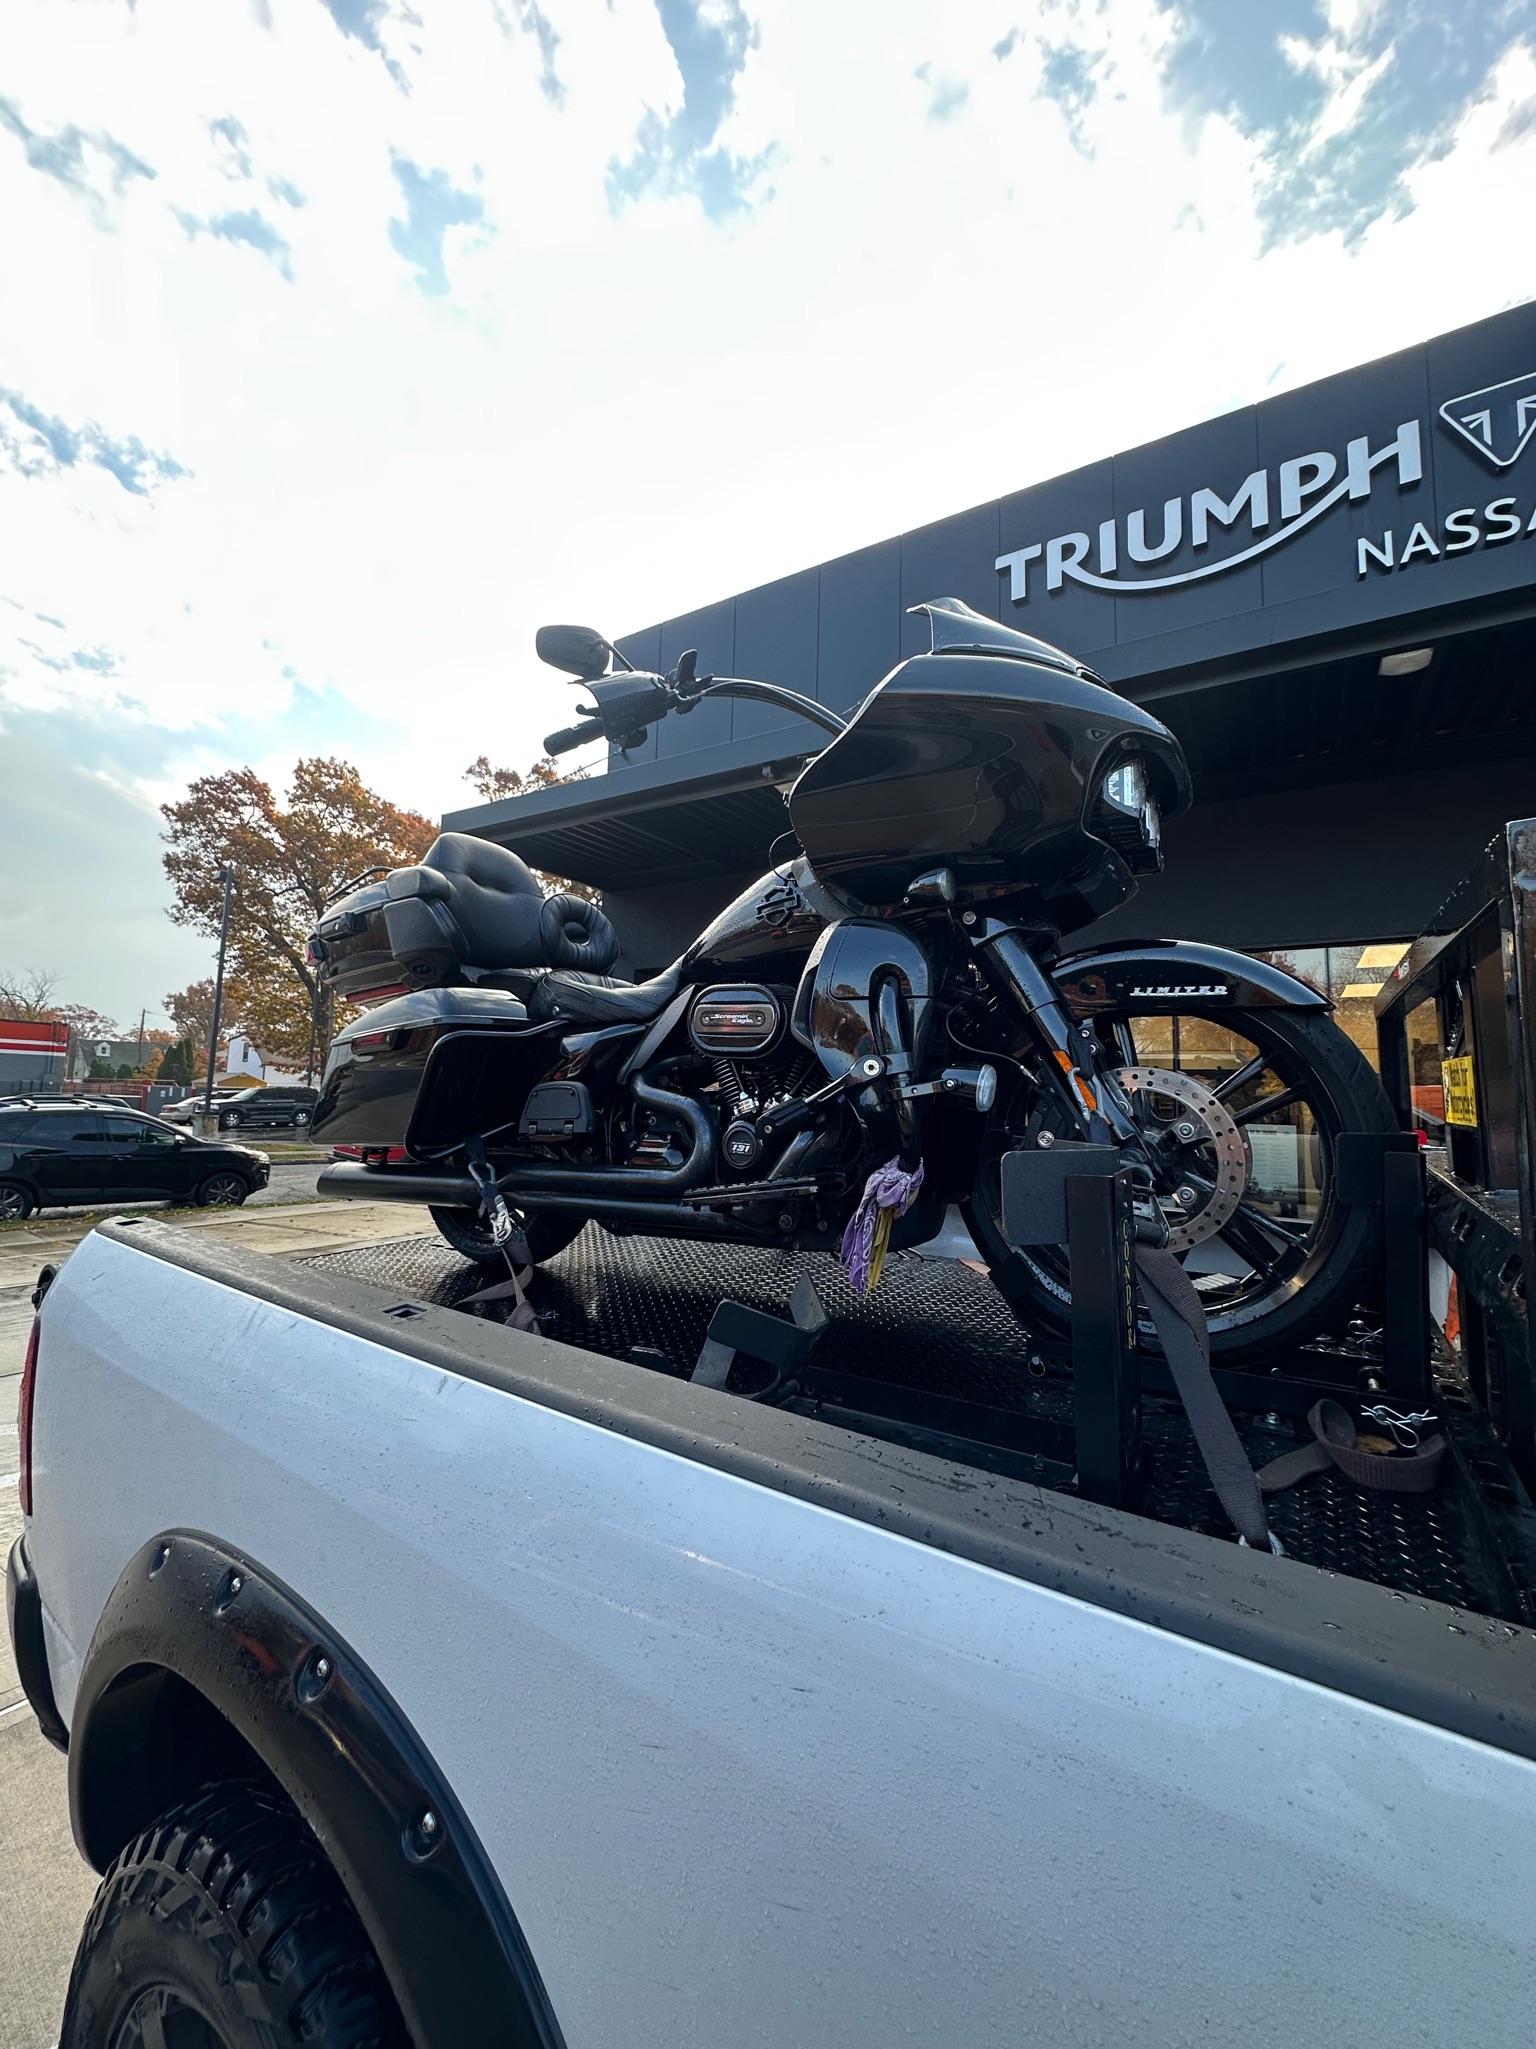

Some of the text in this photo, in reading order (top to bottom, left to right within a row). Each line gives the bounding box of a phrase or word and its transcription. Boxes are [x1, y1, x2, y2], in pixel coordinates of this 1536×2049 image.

[995, 419, 1423, 601] TRIUMPH
[1357, 497, 1536, 574] NASS
[1130, 985, 1228, 996] LIMITED
[1123, 1219, 1135, 1350] CONDOR
